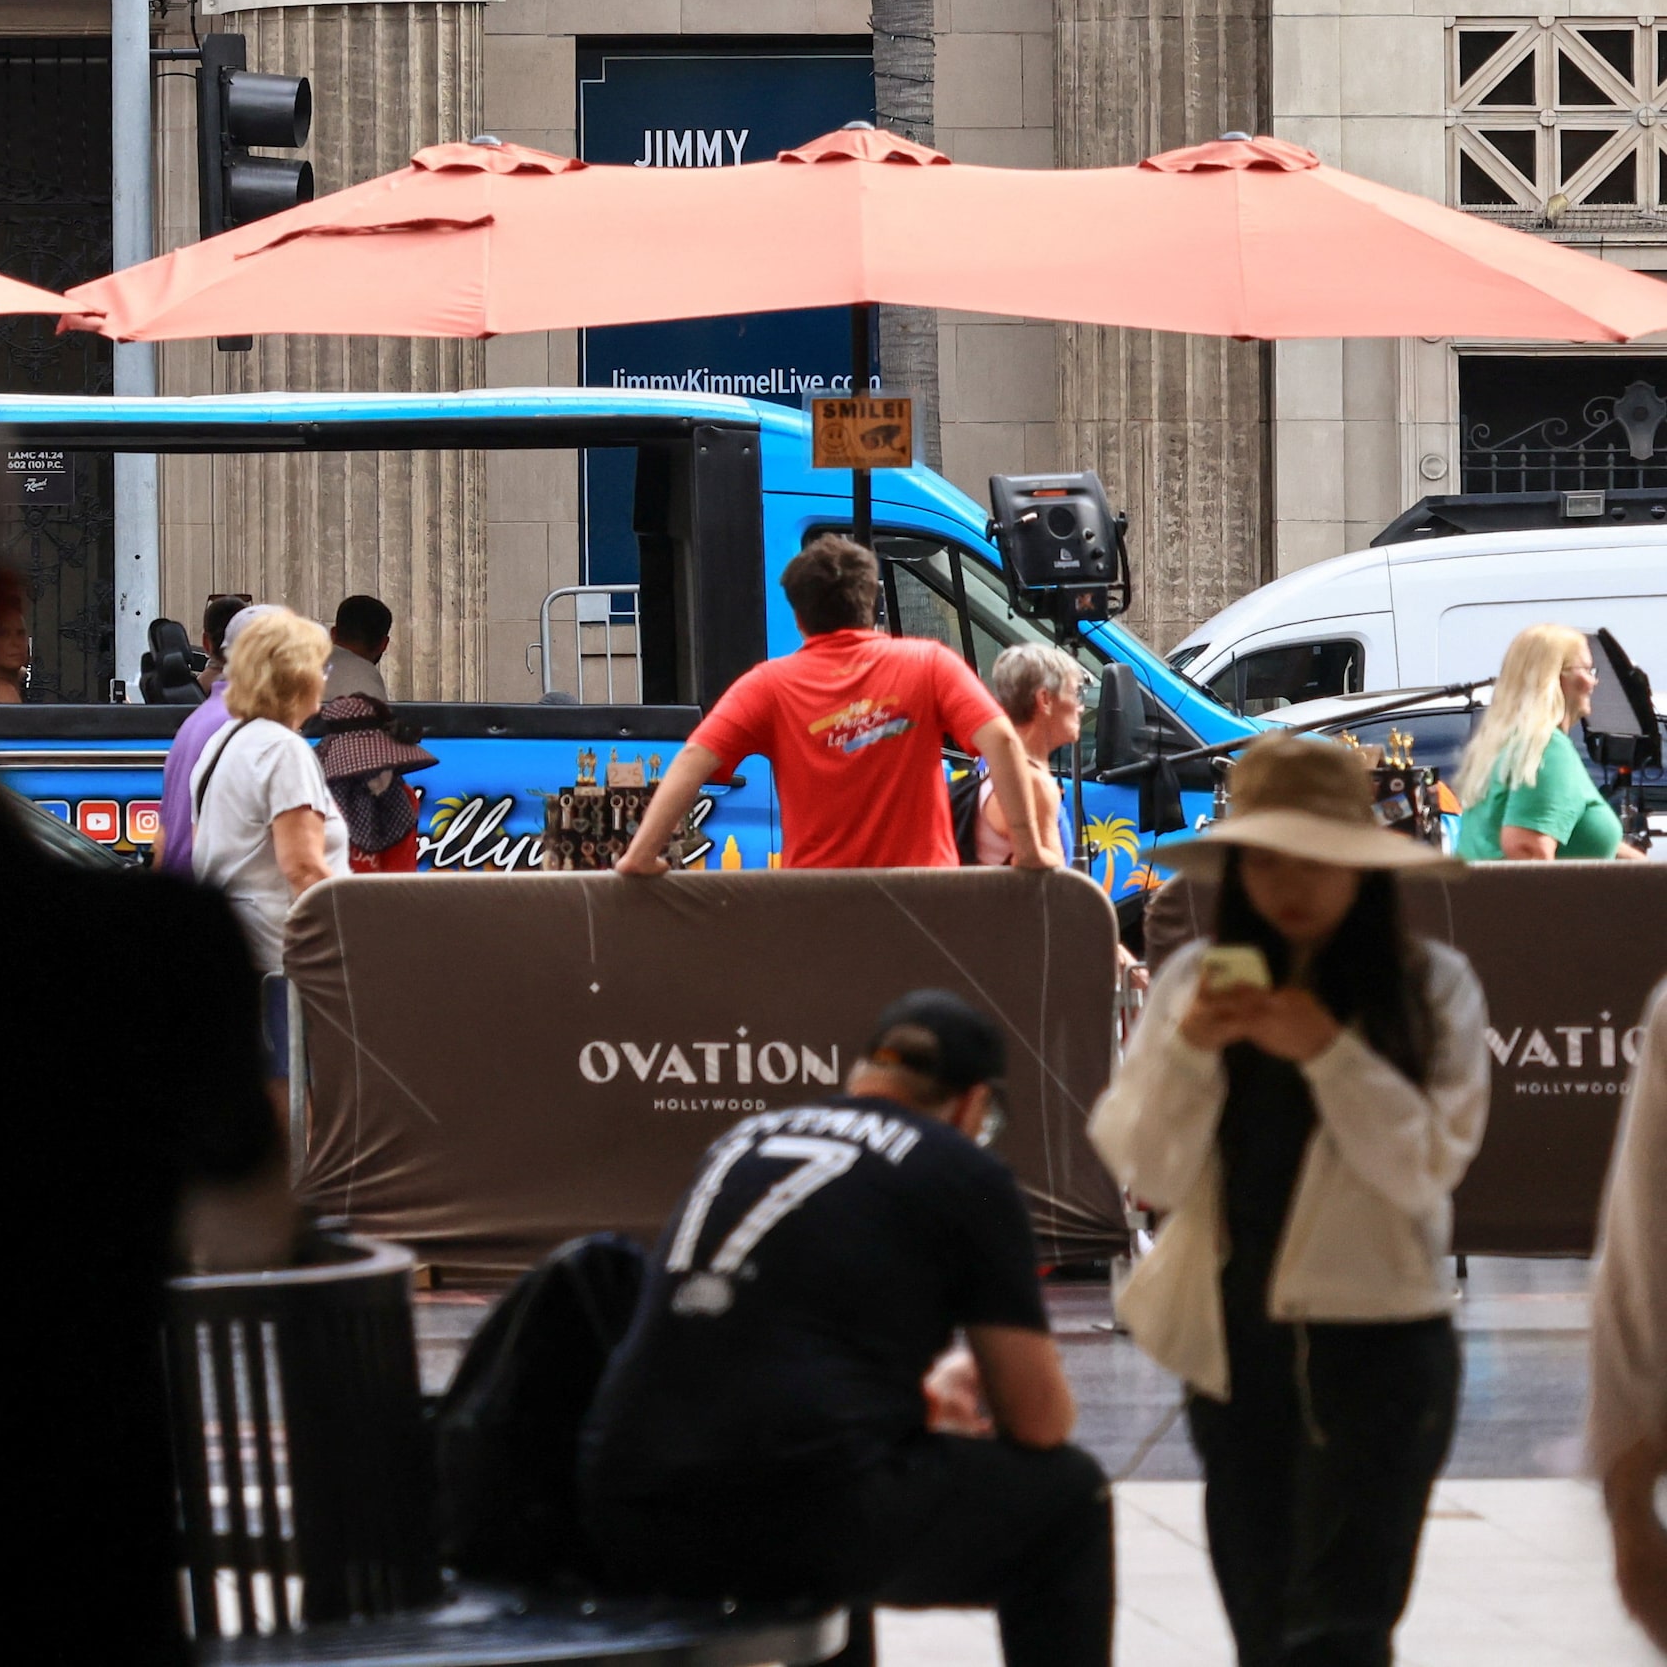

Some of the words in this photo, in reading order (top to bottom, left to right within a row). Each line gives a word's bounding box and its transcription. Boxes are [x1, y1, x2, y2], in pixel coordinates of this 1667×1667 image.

[633, 129, 749, 168] JIMMY
[7, 460, 26, 469] 602
[28, 460, 45, 470] (10)
[47, 460, 64, 469] P.C.
[8, 451, 36, 460] LAMC
[38, 451, 64, 460] 41.24
[1484, 1011, 1646, 1067] VATIO
[653, 1098, 766, 1111] HOLLYWOOD
[665, 1134, 861, 1274] 17
